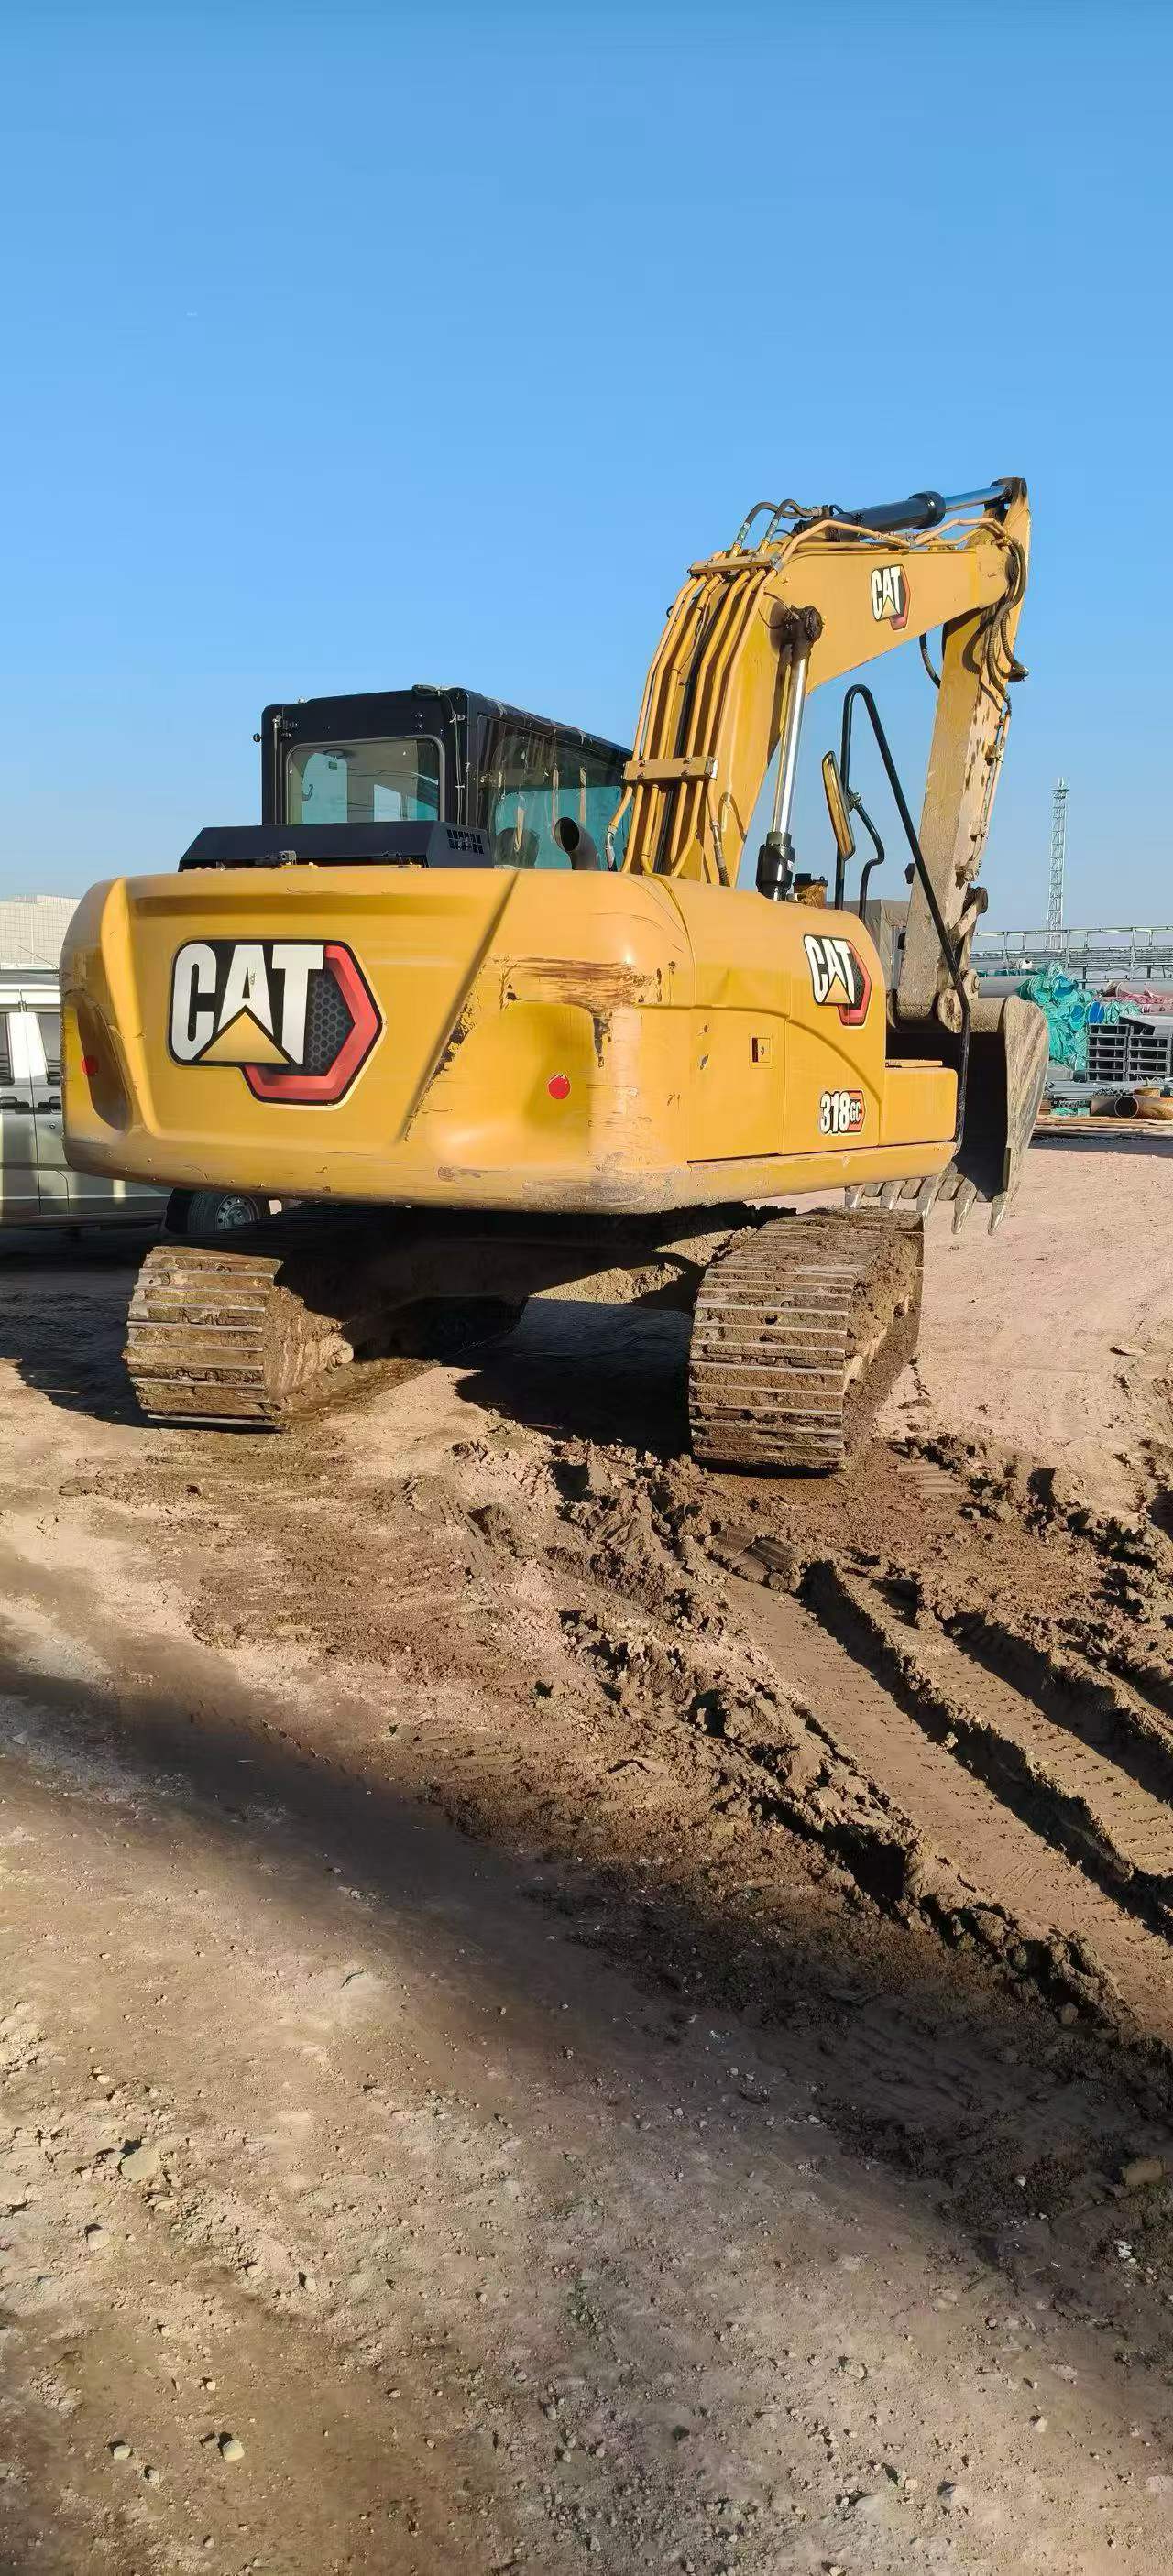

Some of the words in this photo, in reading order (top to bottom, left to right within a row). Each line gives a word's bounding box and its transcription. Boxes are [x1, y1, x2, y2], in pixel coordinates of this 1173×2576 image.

[872, 566, 901, 620] CAT
[804, 935, 855, 1004] CAT
[171, 943, 324, 1064] CAT
[820, 1092, 850, 1133] 318
[850, 1101, 861, 1123] GC
